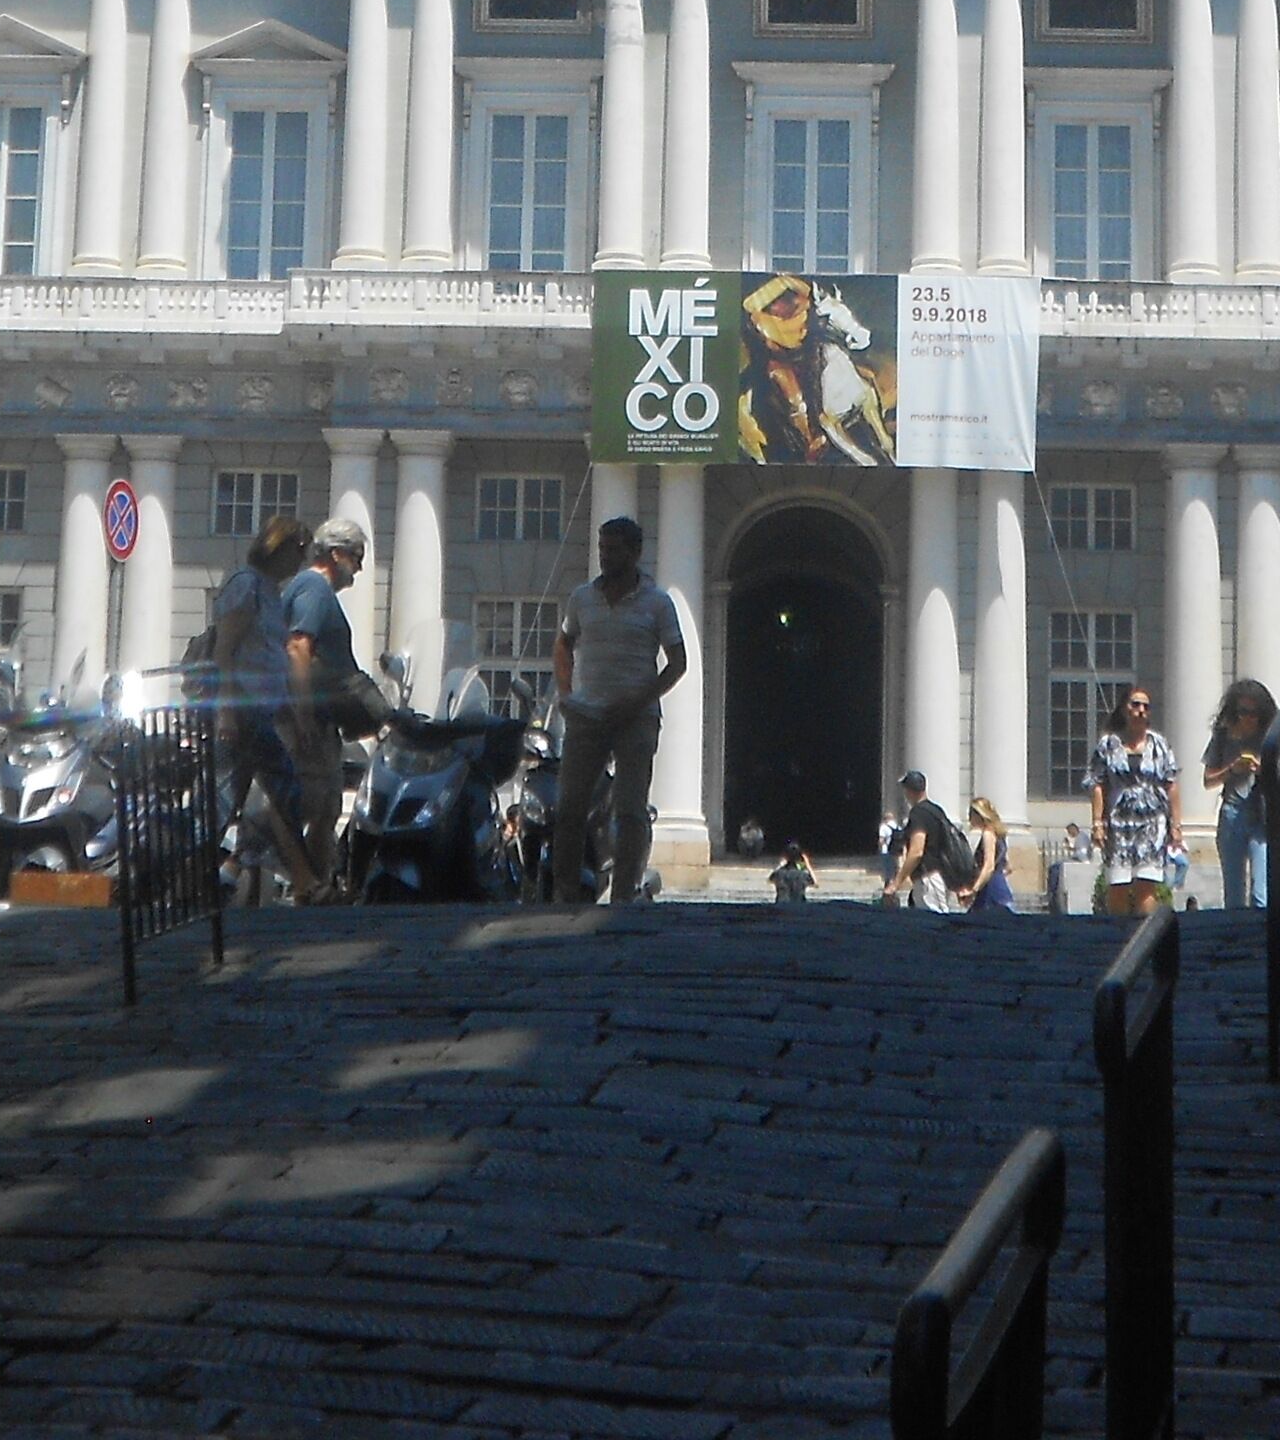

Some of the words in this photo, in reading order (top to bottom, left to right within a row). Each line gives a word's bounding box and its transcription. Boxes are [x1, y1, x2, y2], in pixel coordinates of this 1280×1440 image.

[911, 287, 951, 302] 23.5
[628, 277, 719, 337] MÉ
[911, 307, 988, 323] 9.9.2018
[911, 330, 995, 344] Appartamento
[633, 336, 704, 384] XI
[625, 382, 720, 433] CO
[910, 413, 989, 424] mostramexico.it
